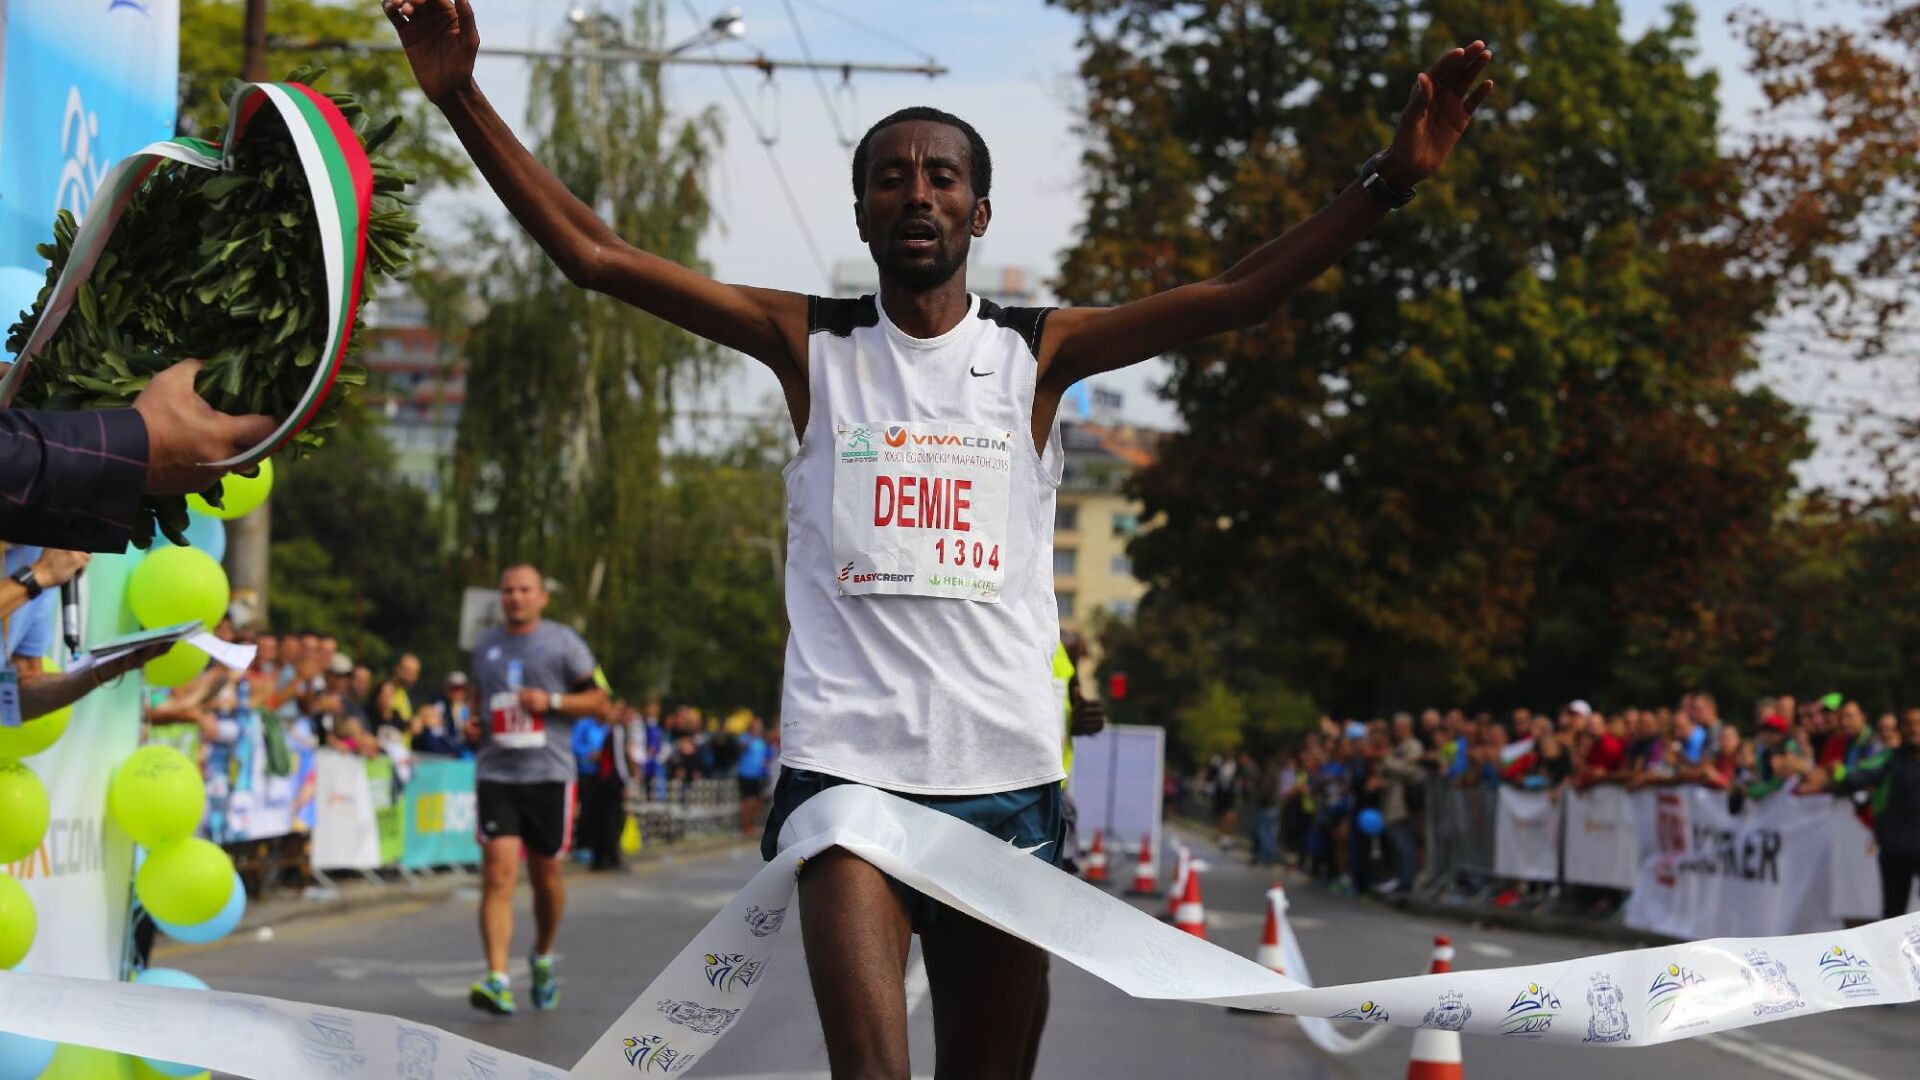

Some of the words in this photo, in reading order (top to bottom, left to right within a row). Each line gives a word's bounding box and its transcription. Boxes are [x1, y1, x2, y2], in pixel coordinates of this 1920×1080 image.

[911, 434, 1006, 451] VIVACOM
[951, 454, 991, 468] МАРАТОН
[874, 475, 972, 532] DEMIE
[935, 538, 1000, 571] 1304
[853, 573, 914, 583] EASYCREDIT
